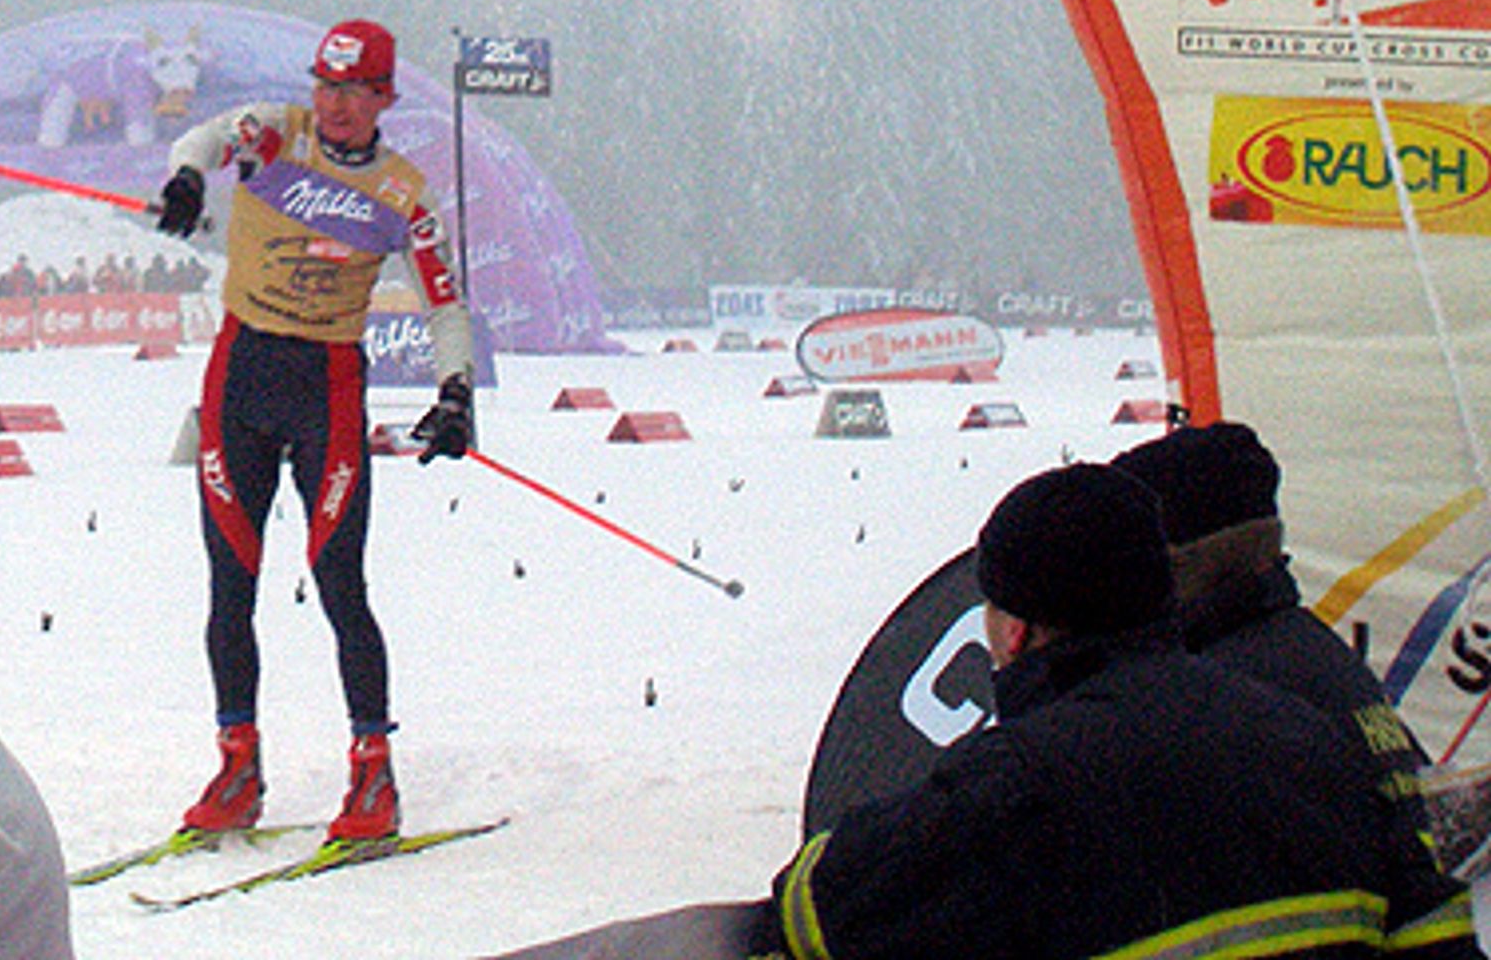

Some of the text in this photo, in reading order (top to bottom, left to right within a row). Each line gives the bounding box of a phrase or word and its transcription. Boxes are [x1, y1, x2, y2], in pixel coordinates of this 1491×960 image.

[1228, 38, 1307, 53] WORLD
[1316, 41, 1358, 54] CUP
[1371, 43, 1445, 59] CROSS
[1303, 138, 1469, 196] RAUCH
[281, 177, 377, 222] Milka
[998, 294, 1072, 315] CRAFT
